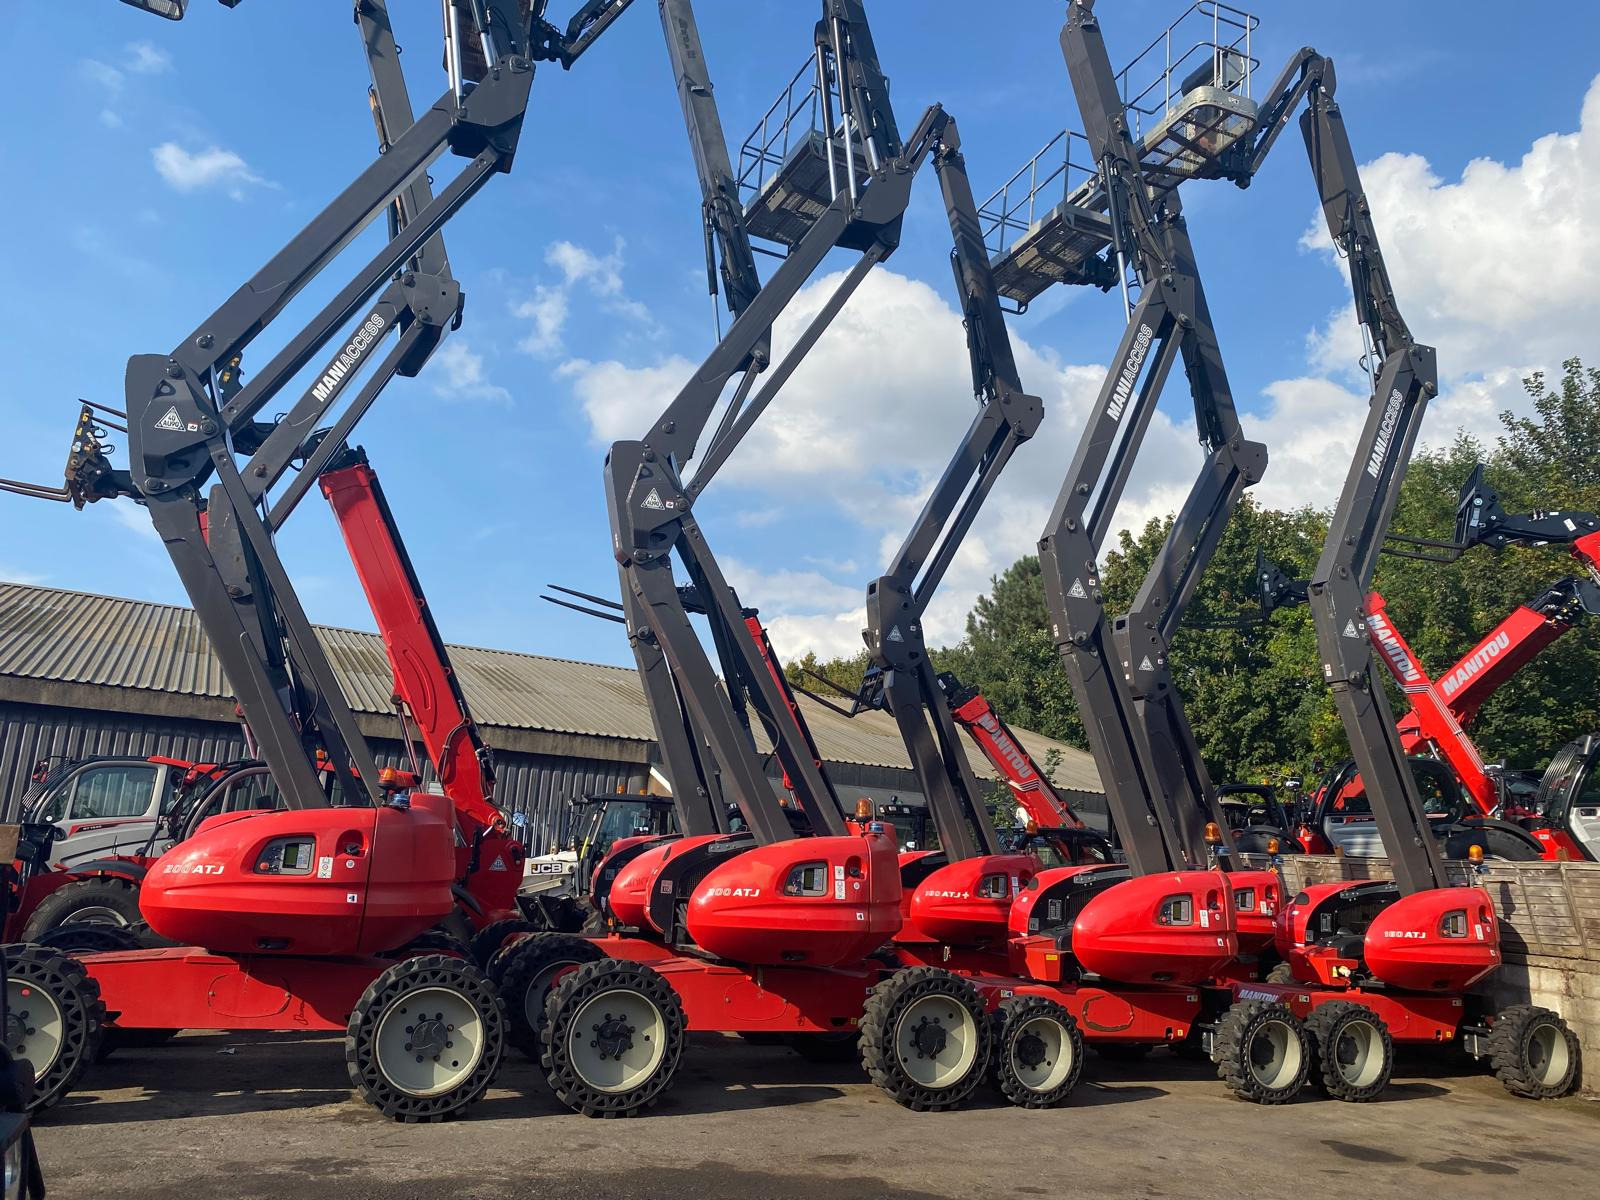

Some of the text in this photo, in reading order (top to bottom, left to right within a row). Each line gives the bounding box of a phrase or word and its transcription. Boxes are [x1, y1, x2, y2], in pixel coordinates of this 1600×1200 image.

[312, 313, 385, 402] MANIACCESS
[1106, 323, 1153, 421] MANIACCESS
[1367, 388, 1403, 478] MANIACCESS
[1366, 613, 1421, 681] MANITOU
[1441, 631, 1510, 696] MANITOU
[979, 713, 1033, 778] MANITOU
[191, 864, 225, 875] ATJ
[532, 863, 562, 874] JCB
[732, 888, 760, 897] ATJ
[1404, 931, 1427, 939] ATJ
[1238, 989, 1279, 1003] MANITOU
